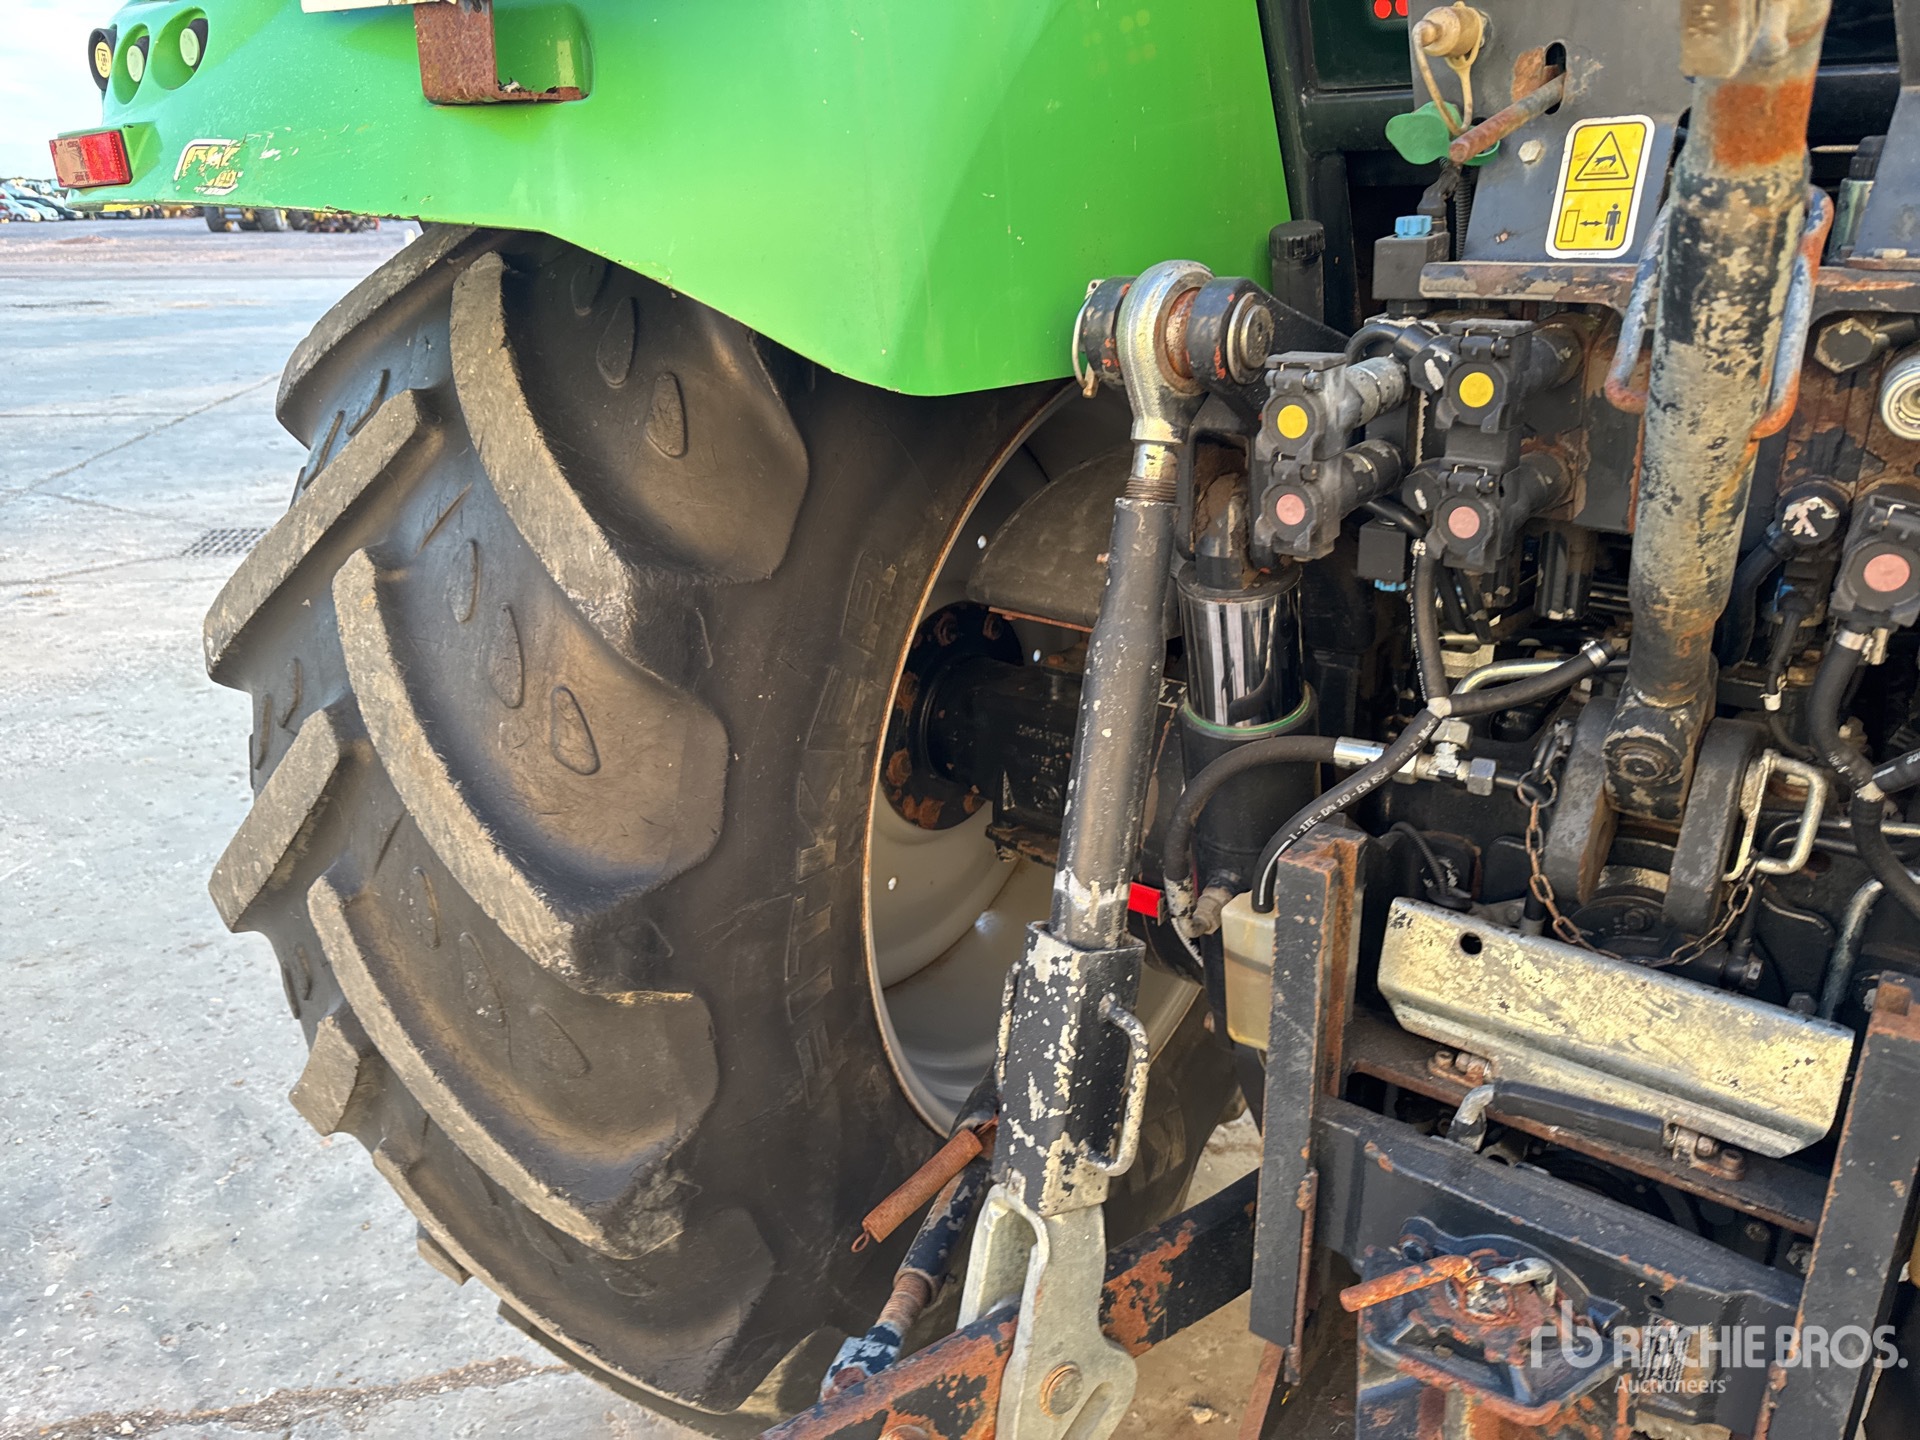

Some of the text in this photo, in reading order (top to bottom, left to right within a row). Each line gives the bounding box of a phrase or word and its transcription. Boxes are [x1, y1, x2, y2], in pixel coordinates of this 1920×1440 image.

[1320, 802, 1338, 817] DN
[1336, 793, 1351, 807] 10
[1355, 780, 1371, 795] EN
